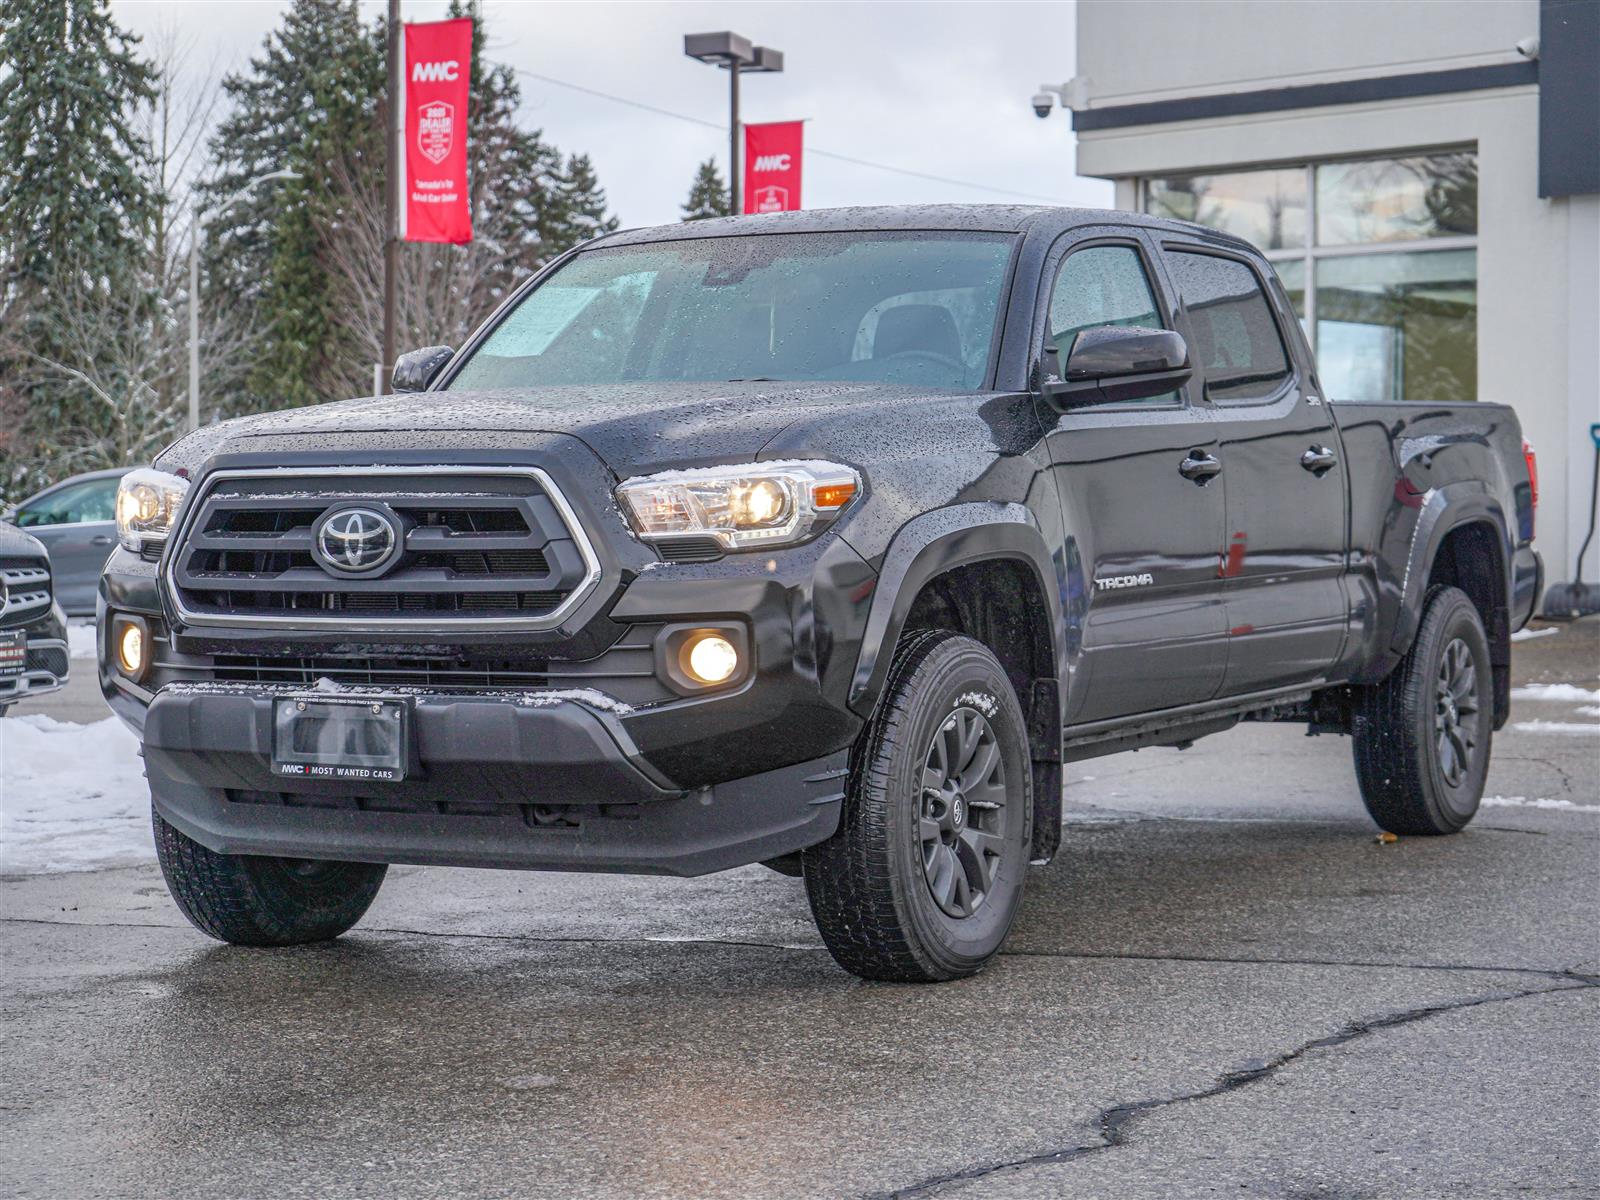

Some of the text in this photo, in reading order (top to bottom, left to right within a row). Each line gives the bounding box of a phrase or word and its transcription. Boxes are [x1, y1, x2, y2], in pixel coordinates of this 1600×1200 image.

[1095, 573, 1153, 590] TACOMA
[281, 764, 393, 779] MWC MOST WANTED CARS
